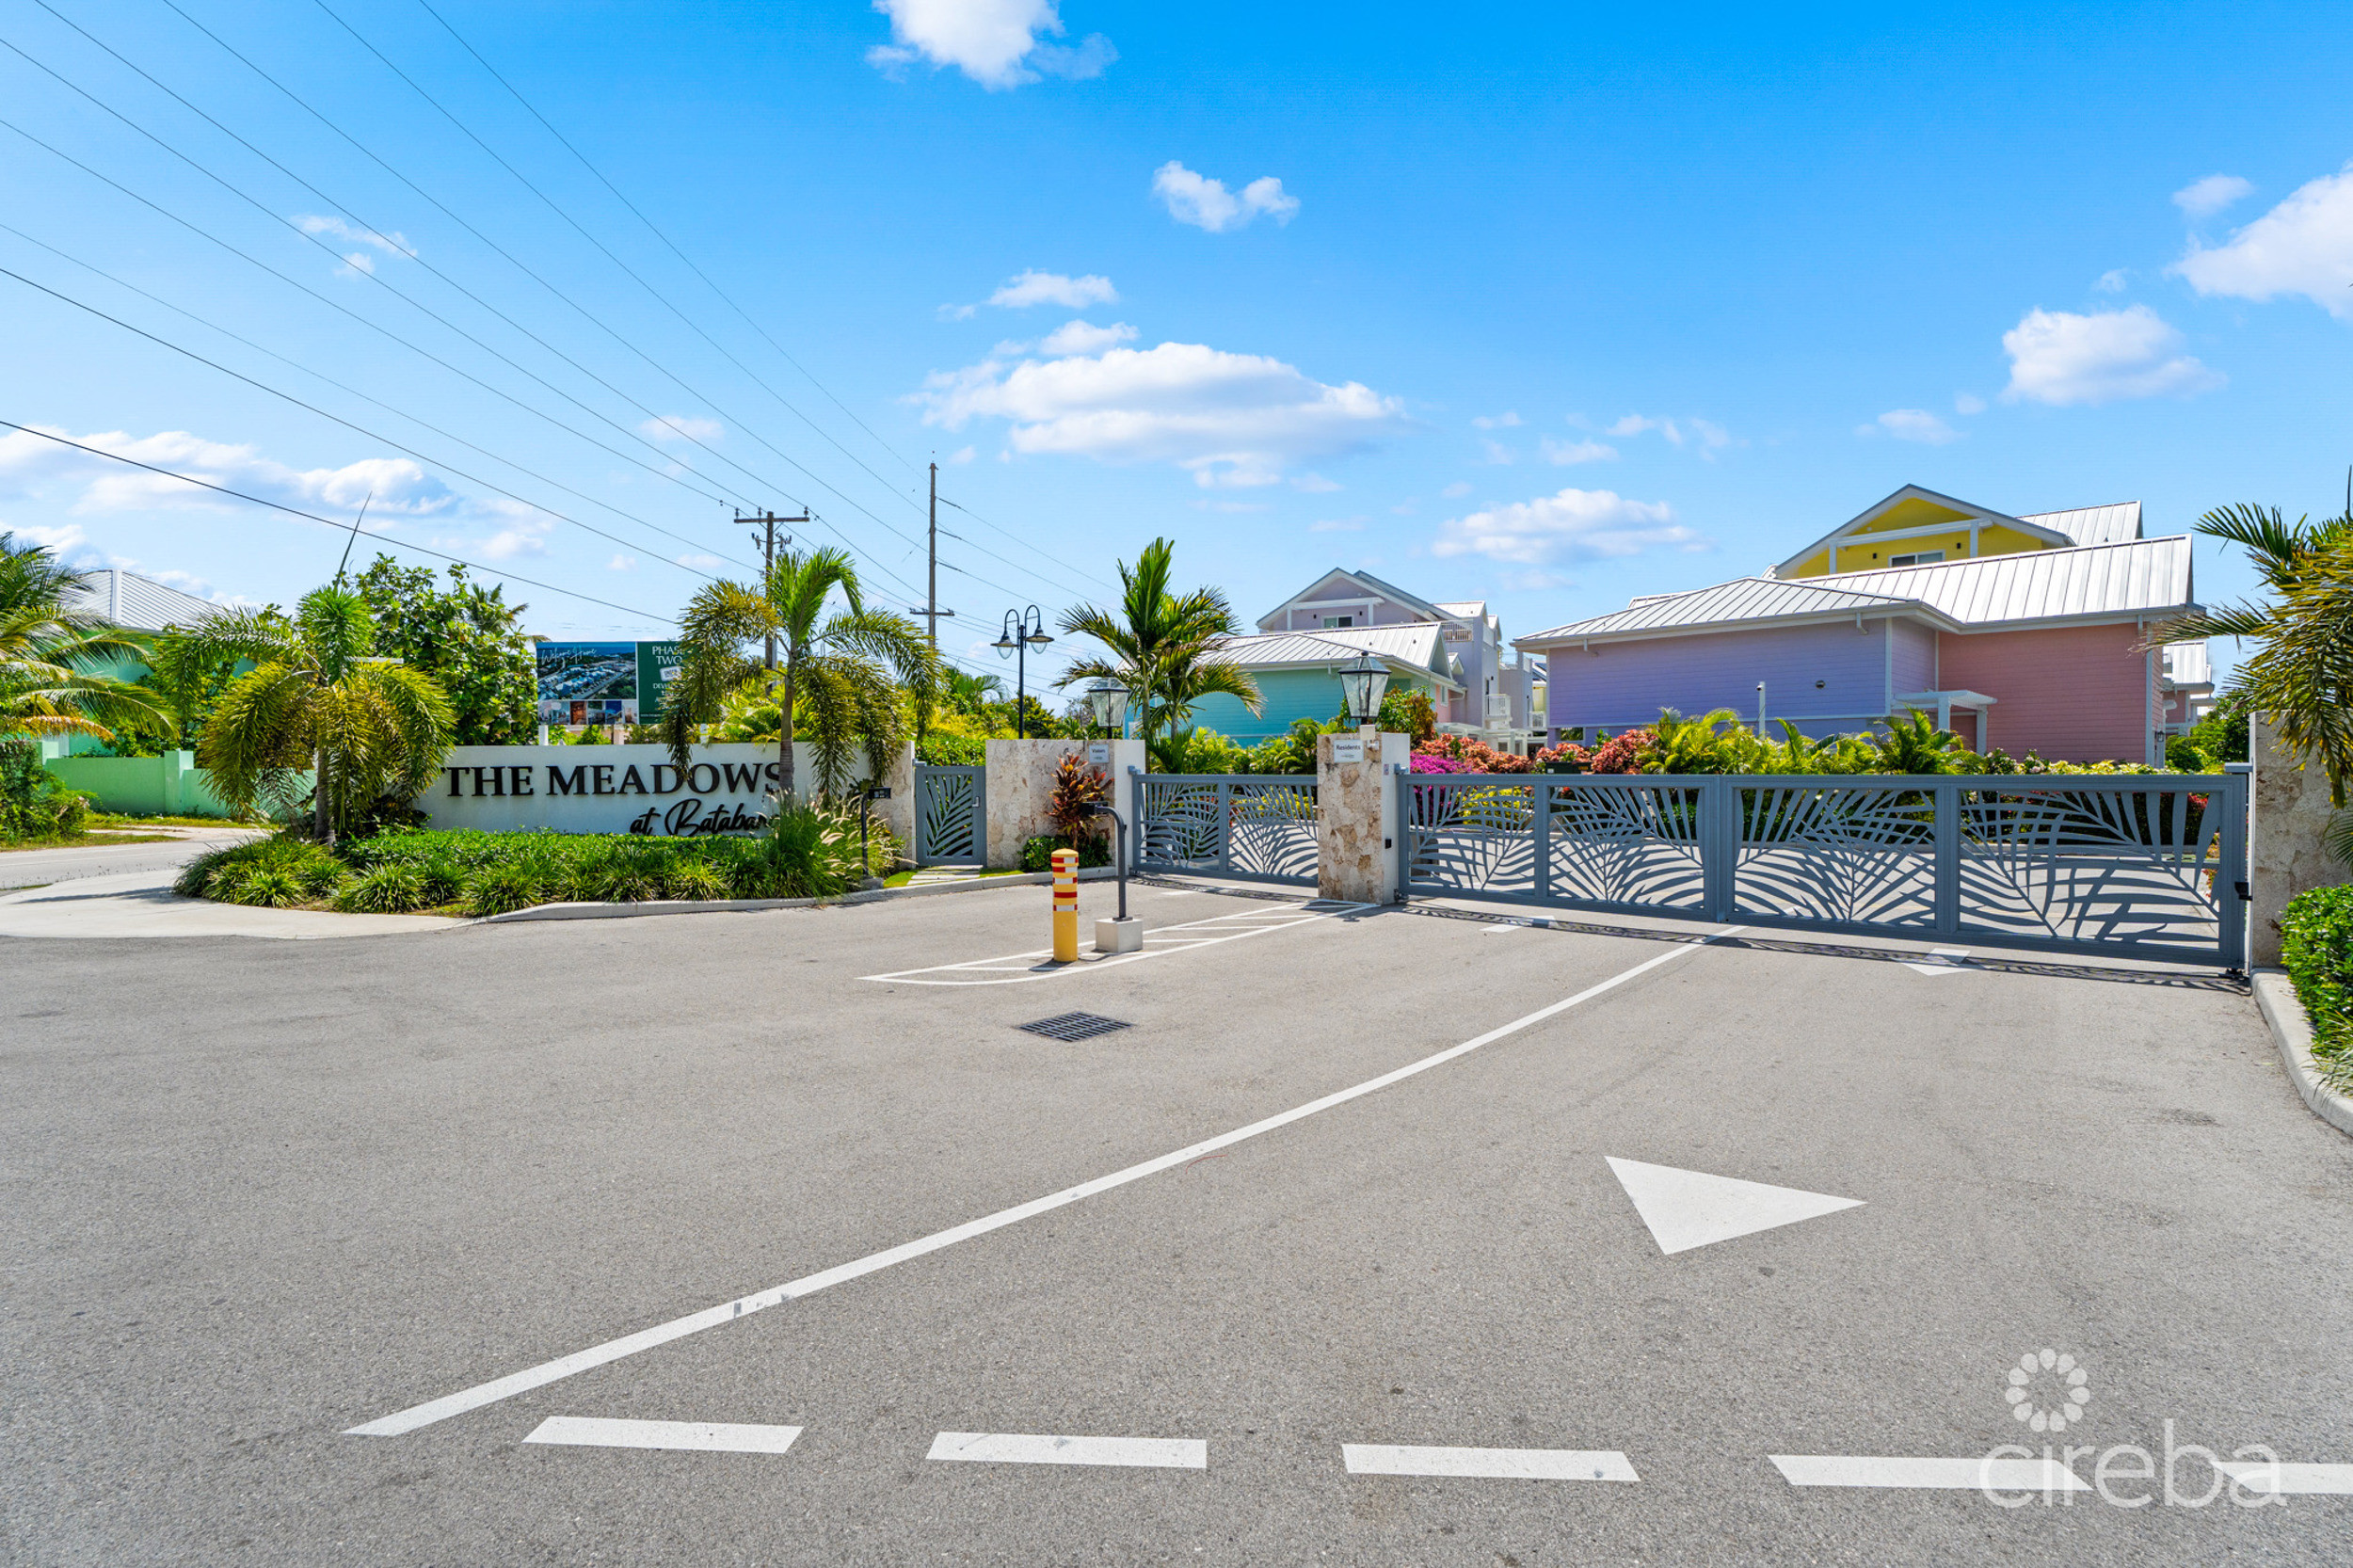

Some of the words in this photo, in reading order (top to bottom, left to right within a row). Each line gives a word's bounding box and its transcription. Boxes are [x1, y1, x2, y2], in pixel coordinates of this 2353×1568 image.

[655, 655, 683, 665] TWO
[440, 766, 535, 797] THE
[545, 761, 780, 795] MEADOWS
[629, 807, 662, 836] at
